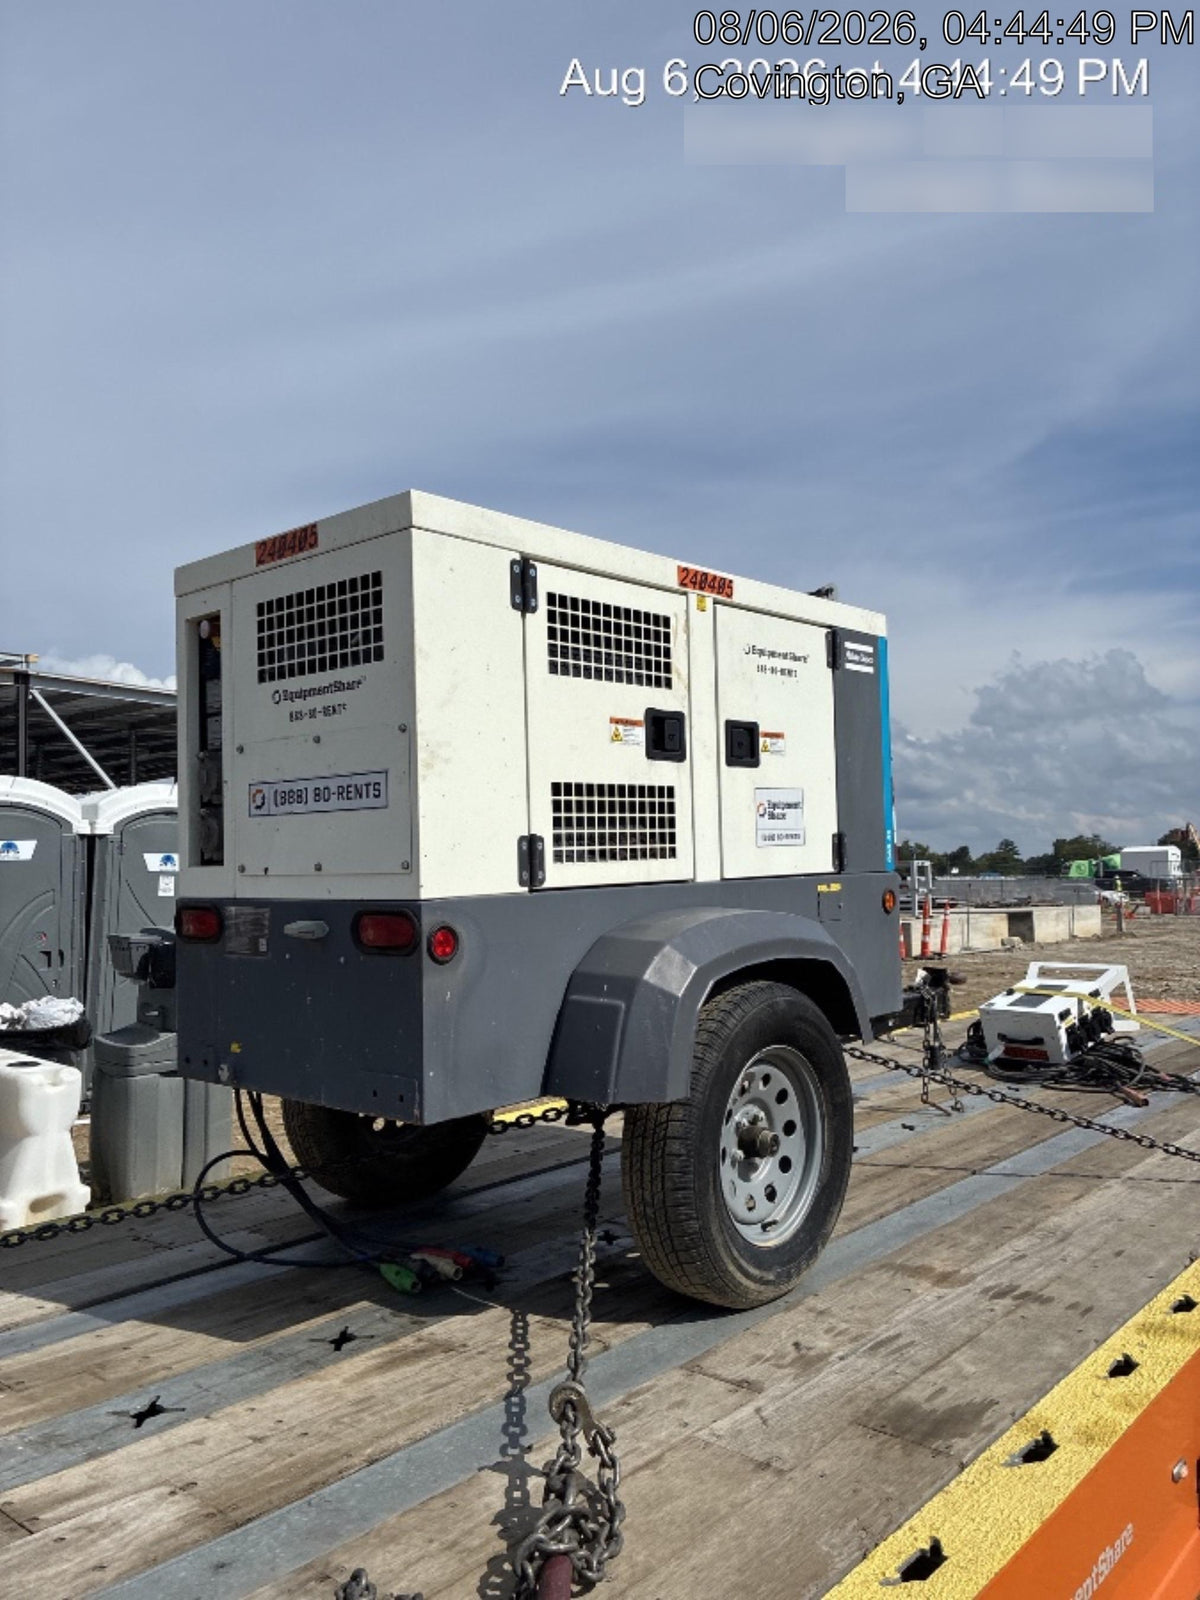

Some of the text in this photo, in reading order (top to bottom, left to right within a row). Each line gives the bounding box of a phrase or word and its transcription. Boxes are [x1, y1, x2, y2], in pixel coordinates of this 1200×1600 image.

[256, 524, 318, 566] 240405
[679, 566, 733, 599] 240405
[312, 781, 382, 803] 80-RENTS
